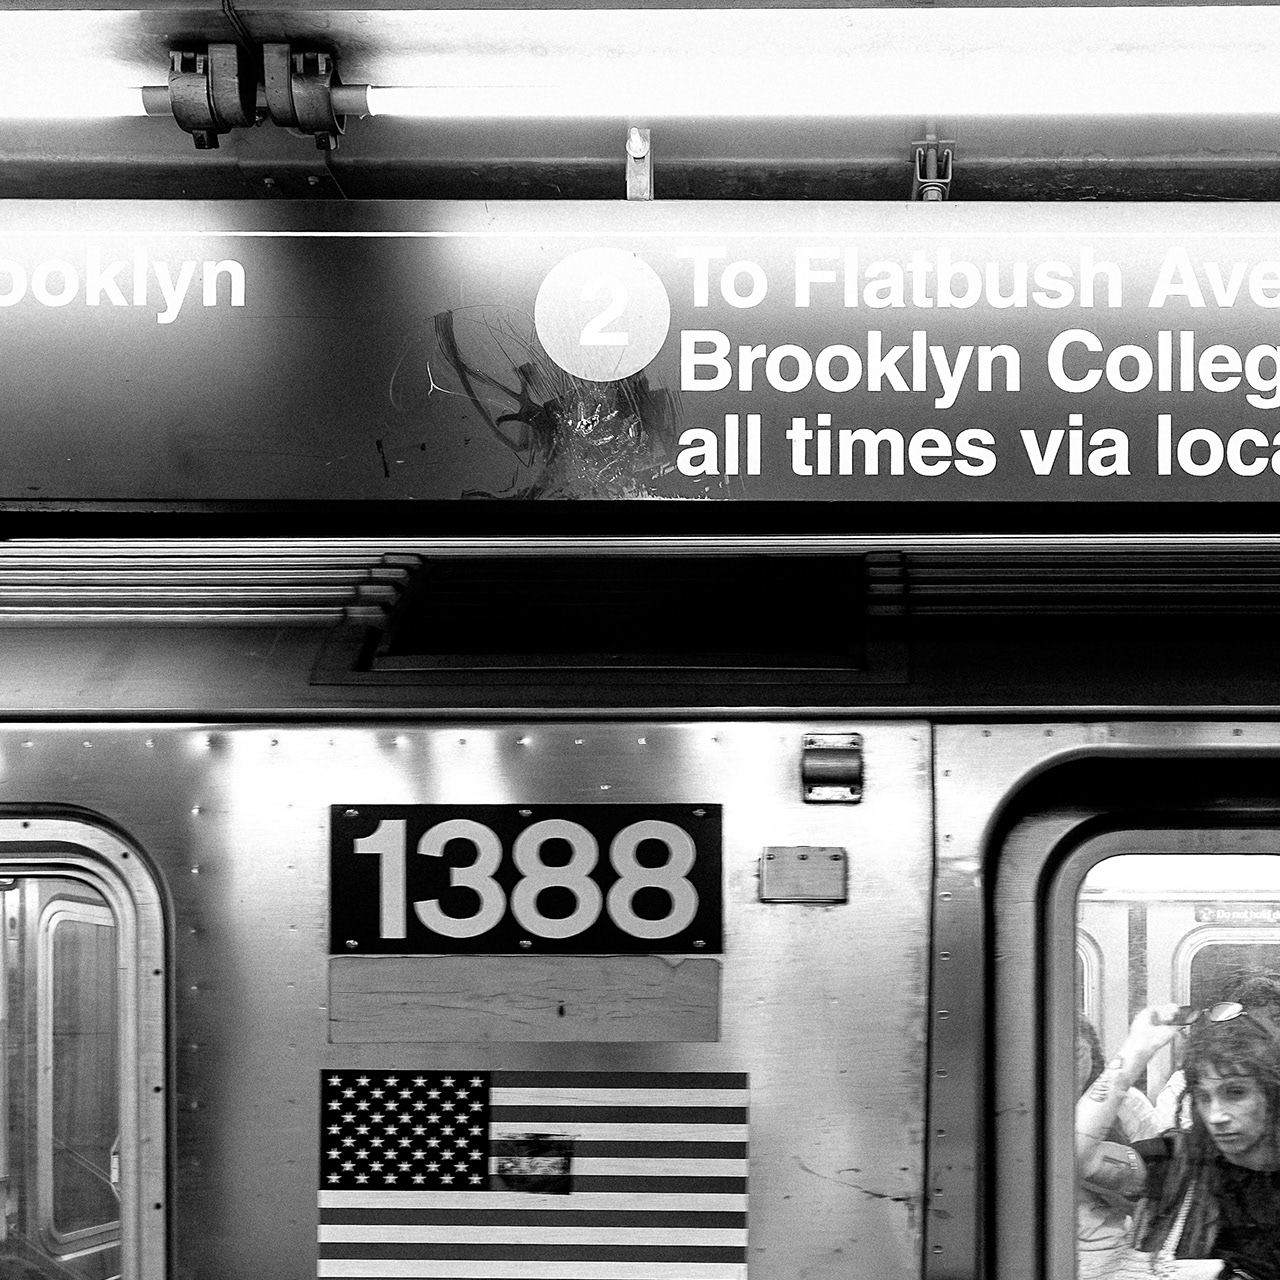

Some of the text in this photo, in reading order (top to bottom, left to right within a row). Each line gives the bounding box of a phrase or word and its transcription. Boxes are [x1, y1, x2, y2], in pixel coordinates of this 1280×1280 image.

[578, 277, 630, 346] 2
[677, 247, 767, 309] To
[796, 247, 1121, 309] Flatbush
[680, 329, 1020, 409] Brooklyn
[677, 413, 760, 477] all
[786, 413, 997, 477] times
[1020, 413, 1130, 477] via
[353, 819, 699, 939] 1388
